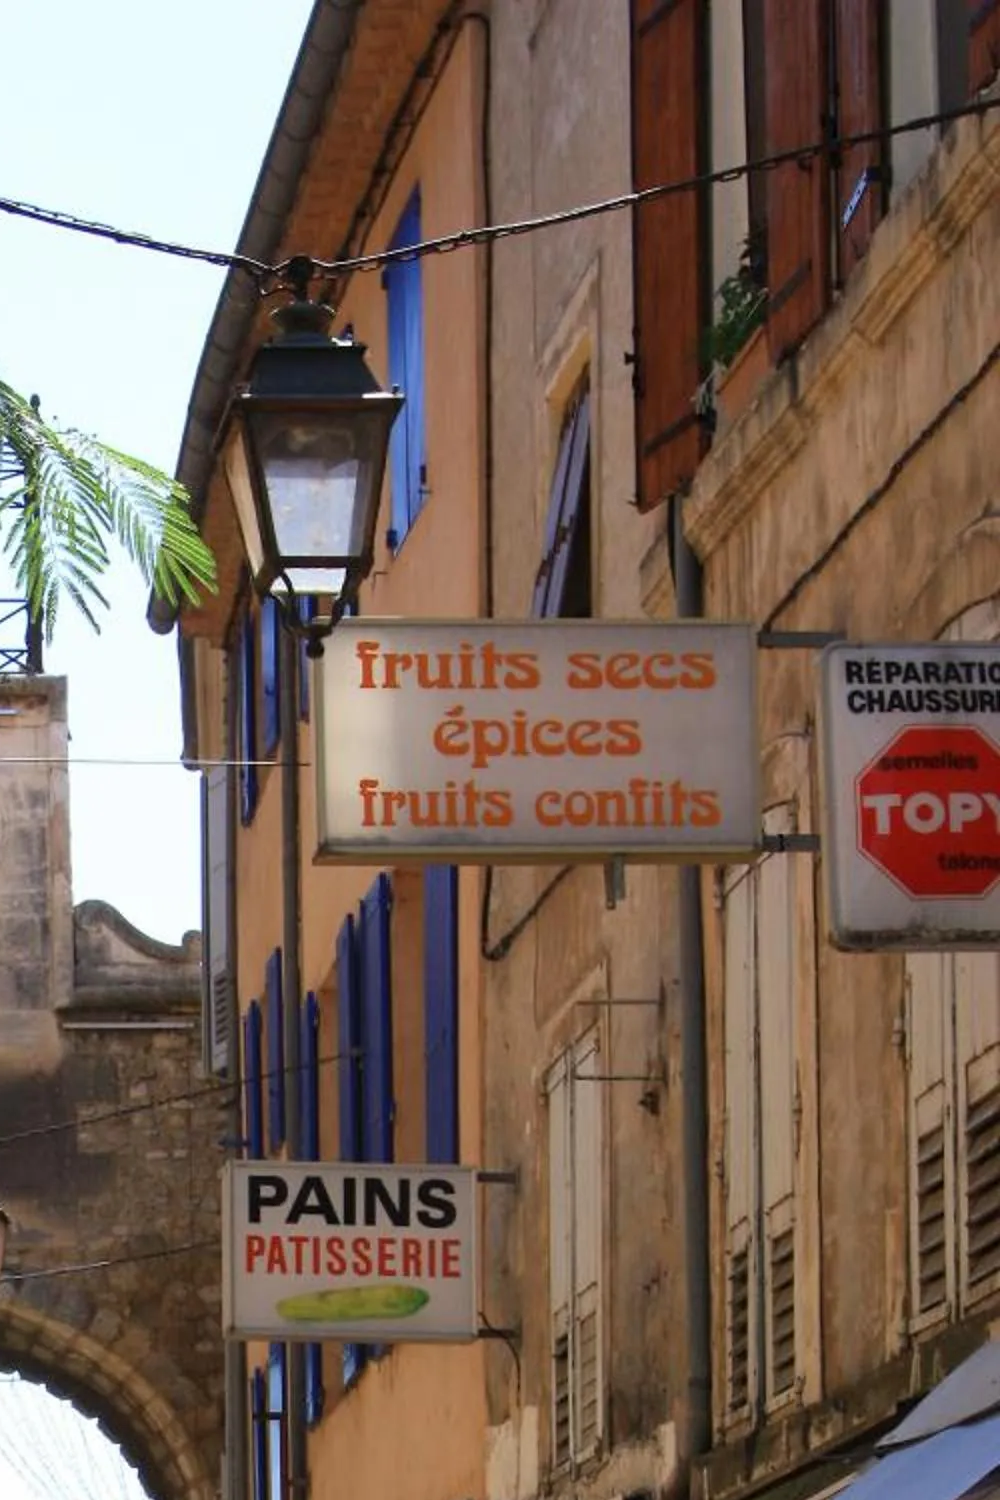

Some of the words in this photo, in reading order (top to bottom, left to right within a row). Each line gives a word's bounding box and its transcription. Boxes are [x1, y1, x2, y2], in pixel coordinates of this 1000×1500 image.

[356, 641, 541, 691] fruits
[566, 651, 717, 691] secs
[432, 704, 643, 768] épices
[879, 752, 979, 770] semelles
[358, 778, 513, 828] fruits
[534, 778, 722, 828] confits
[248, 1175, 457, 1229] PAINS
[245, 1233, 462, 1279] PATISSERIE
